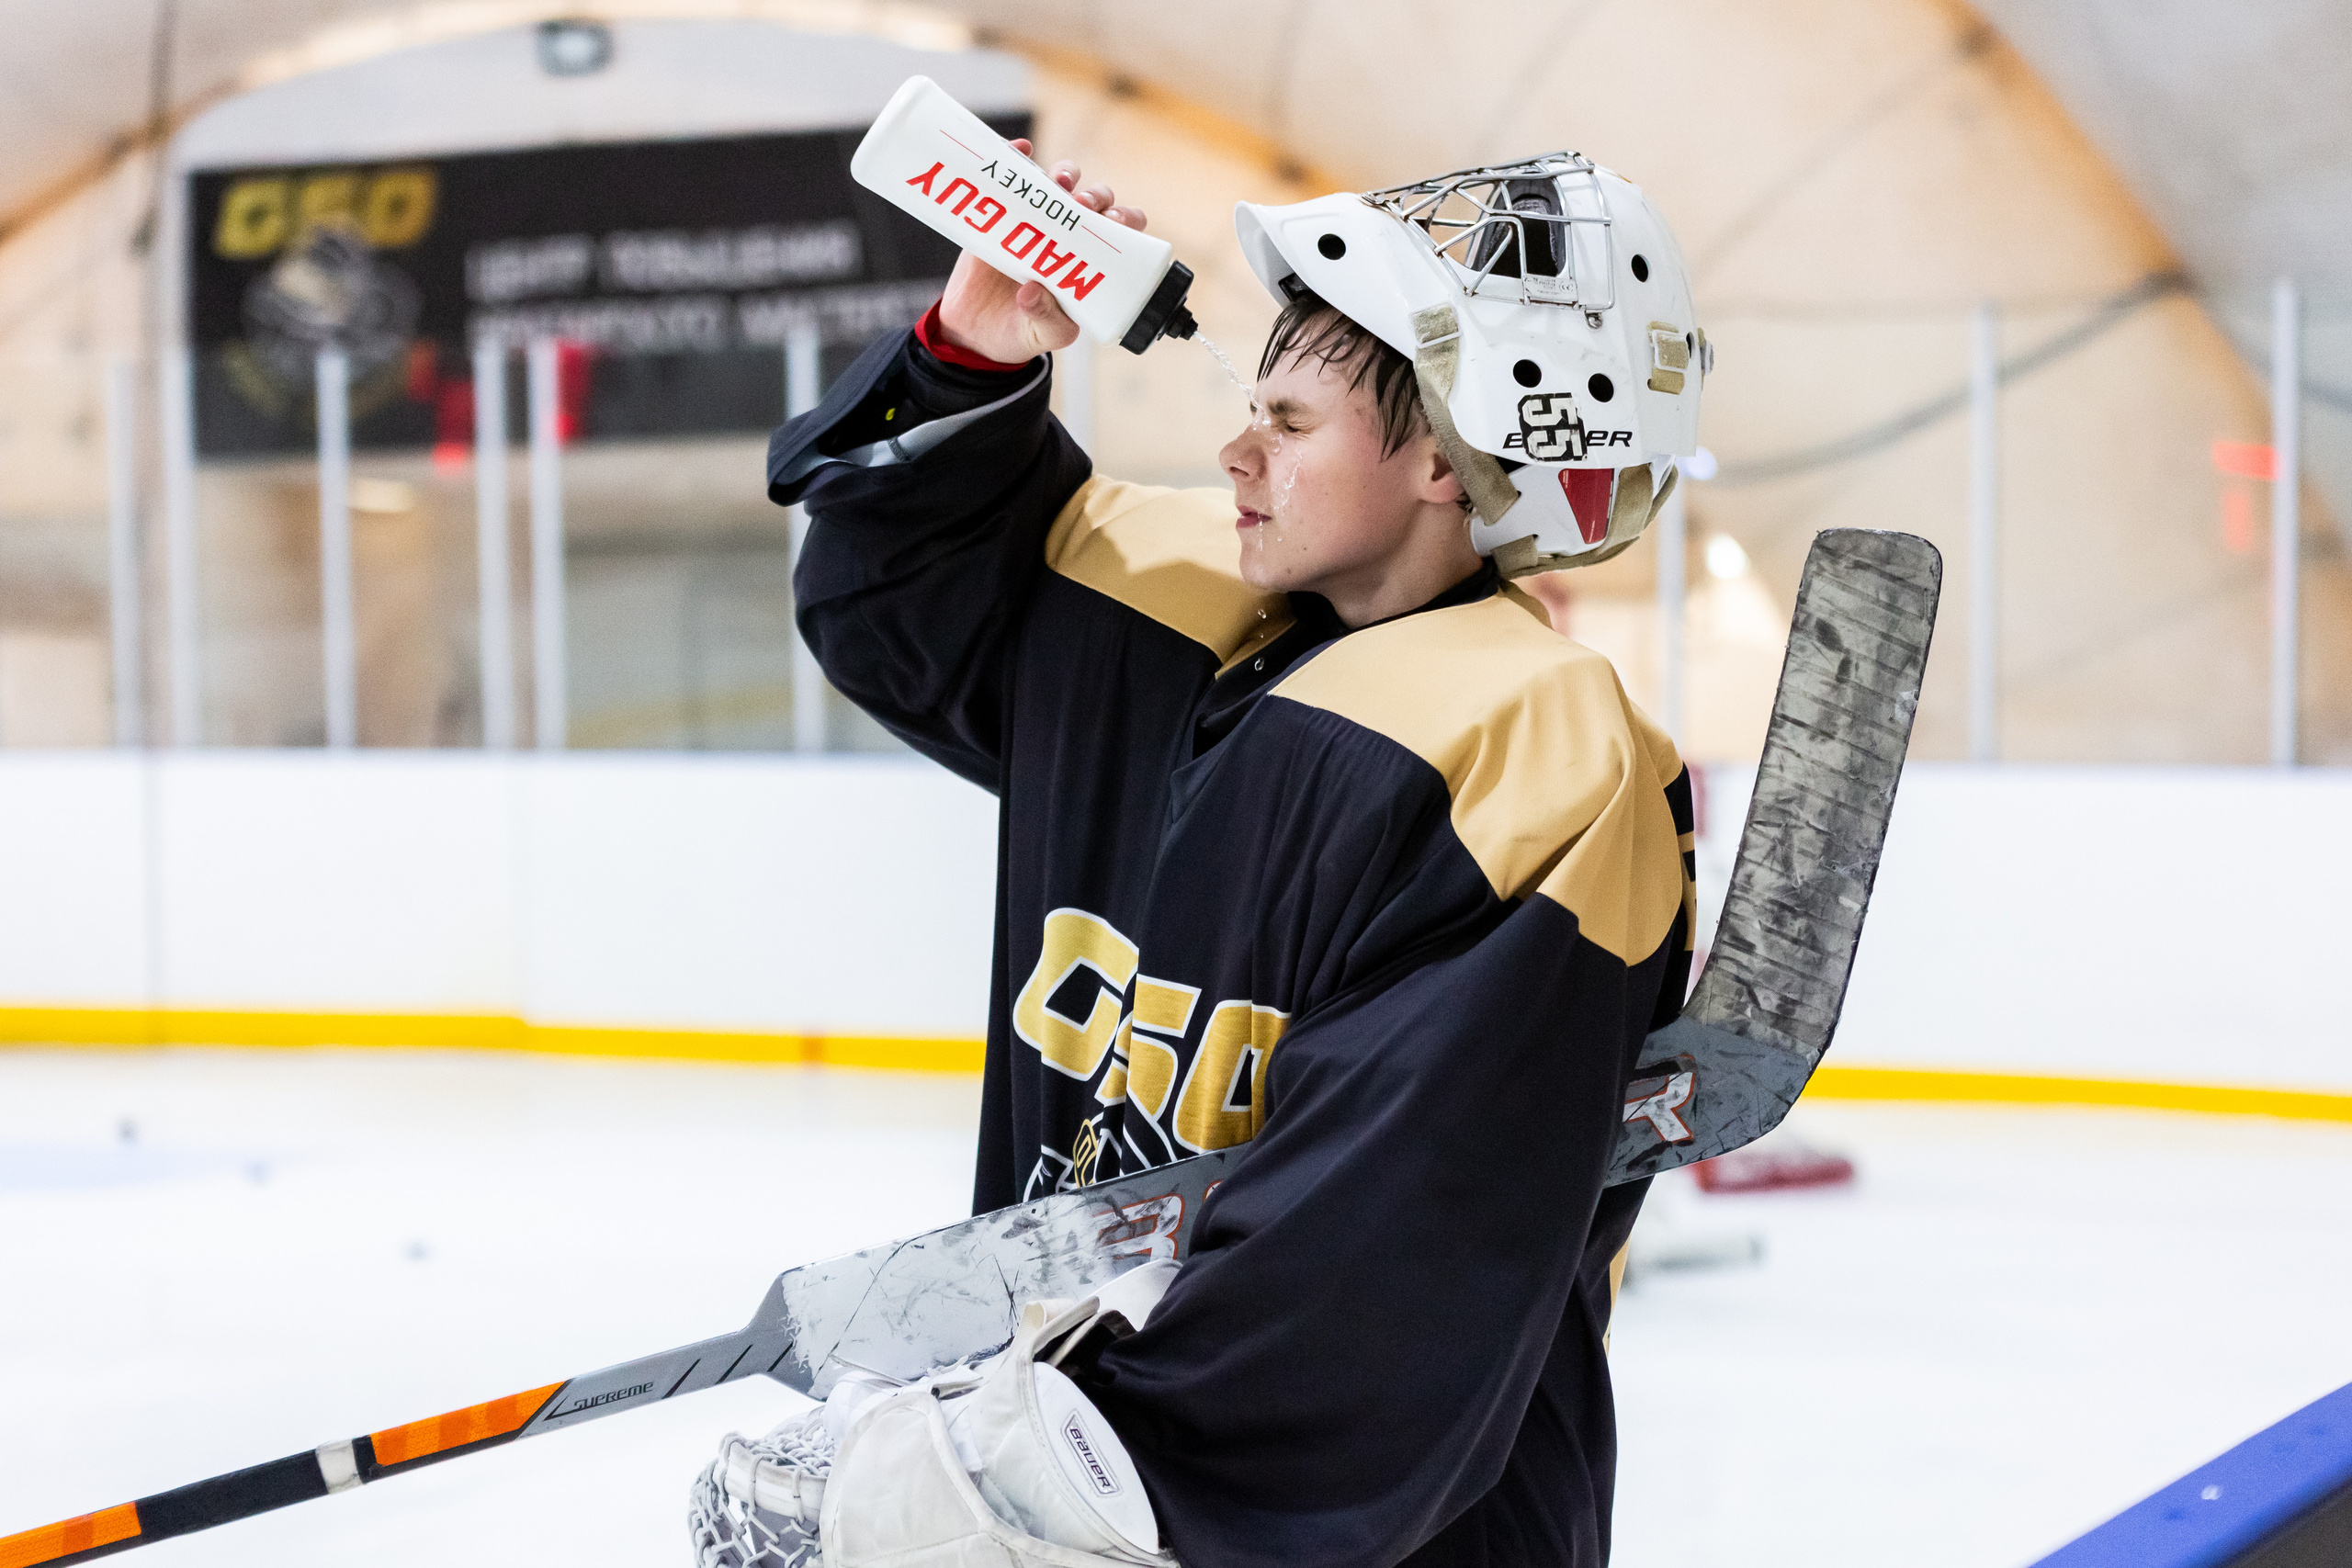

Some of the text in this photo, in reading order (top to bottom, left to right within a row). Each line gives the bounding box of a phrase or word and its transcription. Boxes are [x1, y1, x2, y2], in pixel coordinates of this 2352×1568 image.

[980, 159, 1081, 231] HOCKEY
[905, 161, 1106, 302] MAD GUY
[1501, 430, 1633, 449] BER
[573, 1381, 654, 1411] SUPREME
[1069, 1427, 1111, 1488] BAUER
